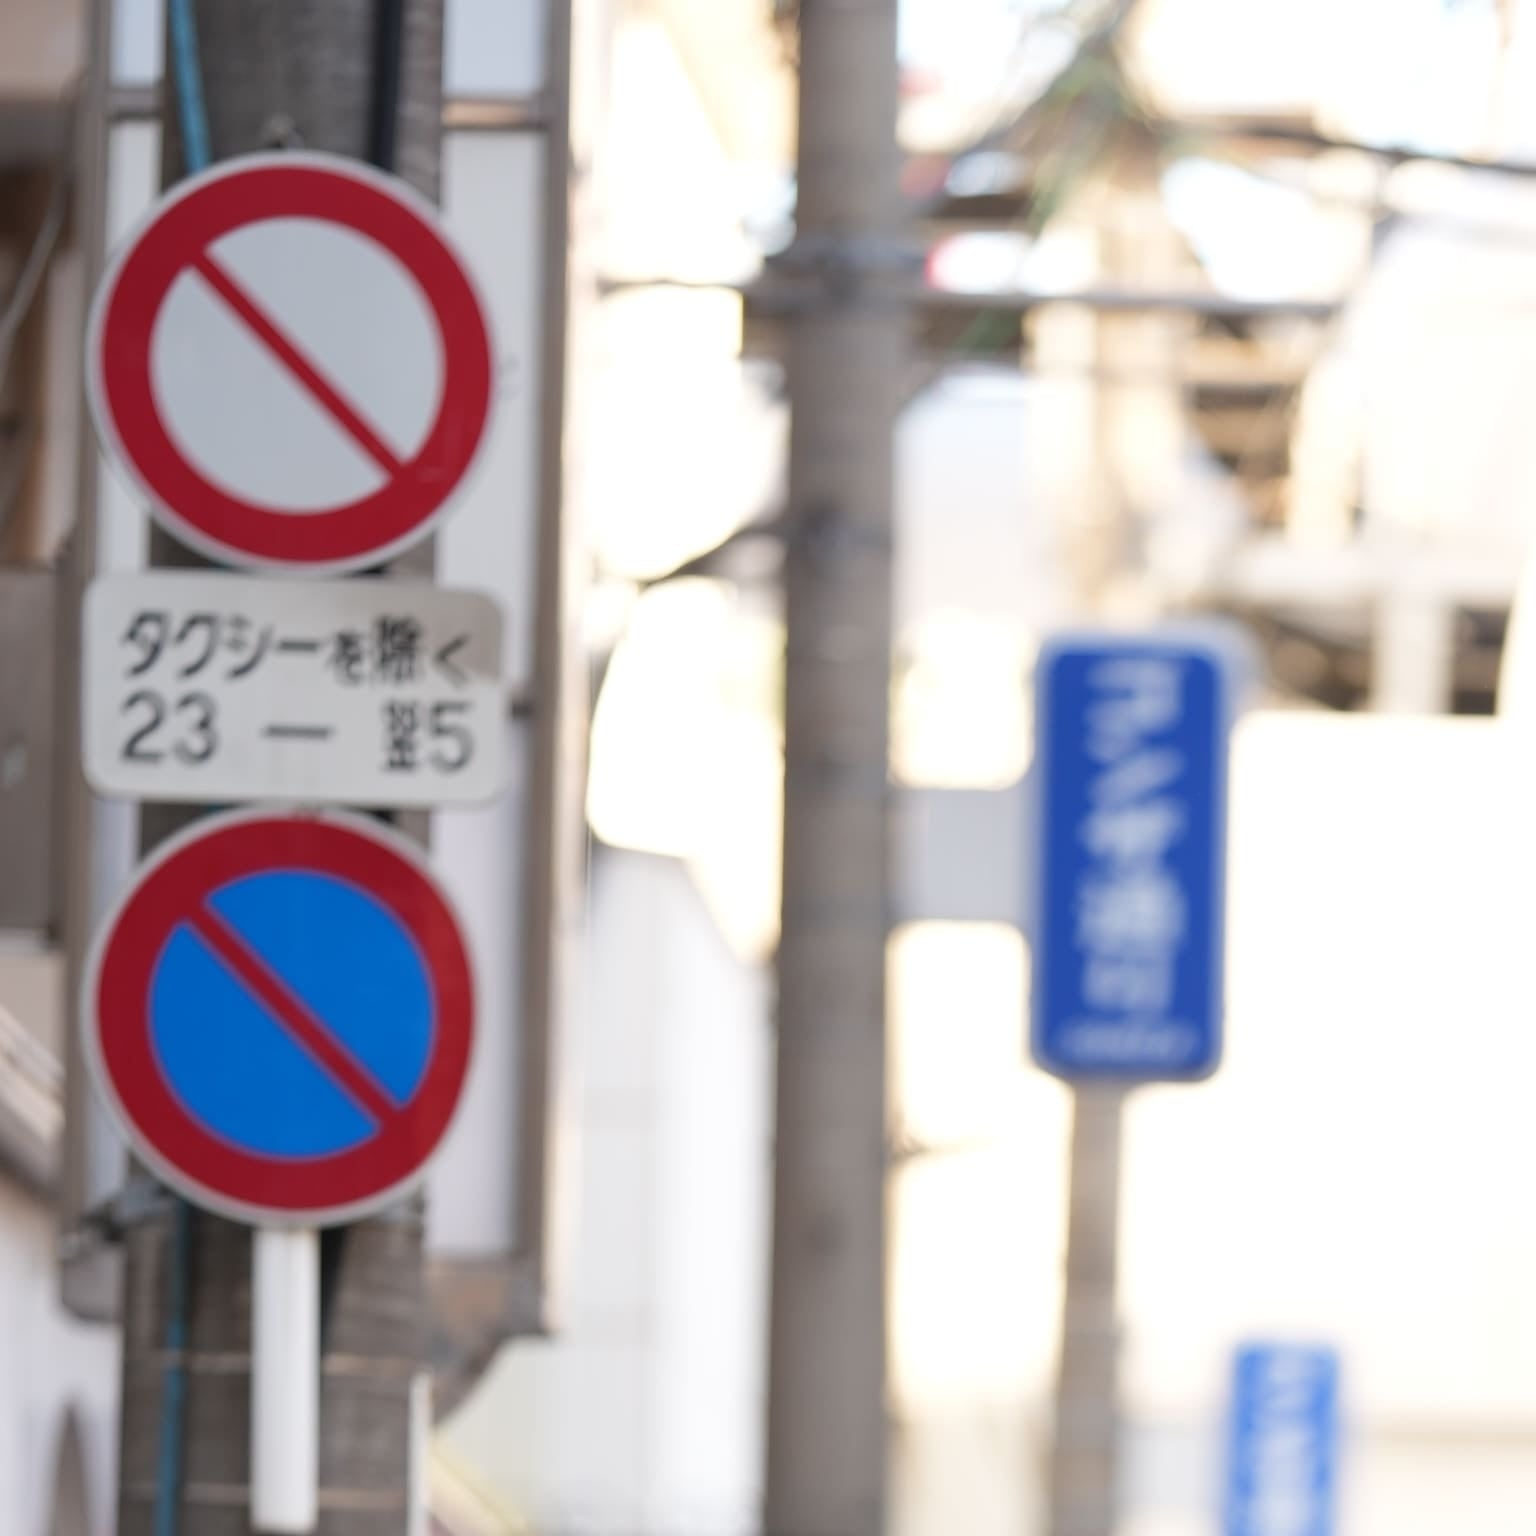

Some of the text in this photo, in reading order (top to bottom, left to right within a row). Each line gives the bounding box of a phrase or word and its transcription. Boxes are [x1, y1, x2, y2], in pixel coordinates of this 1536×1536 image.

[121, 611, 470, 686] タクシーを除く
[120, 690, 219, 766] 23
